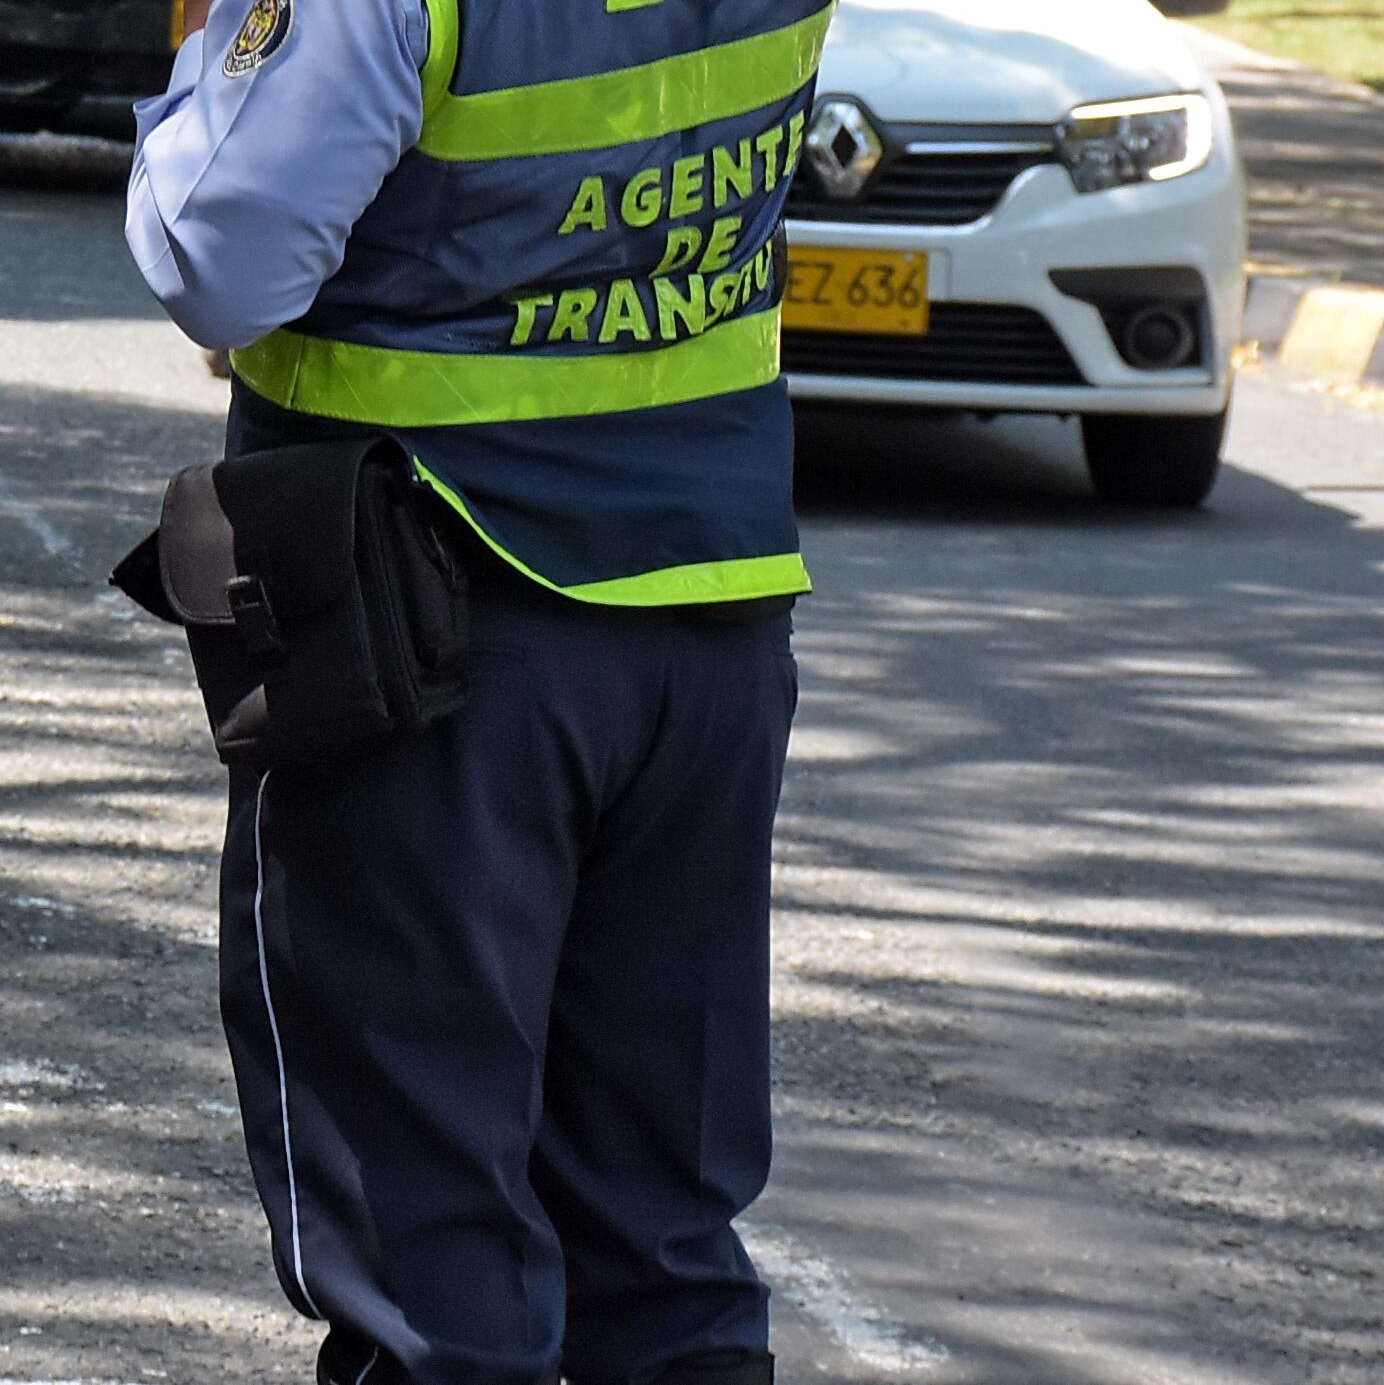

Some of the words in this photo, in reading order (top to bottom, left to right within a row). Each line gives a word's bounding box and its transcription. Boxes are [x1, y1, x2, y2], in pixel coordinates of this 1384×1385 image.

[557, 108, 805, 235] AGENTE
[648, 216, 743, 279] DE
[788, 261, 835, 305] EZ
[847, 266, 920, 308] 636
